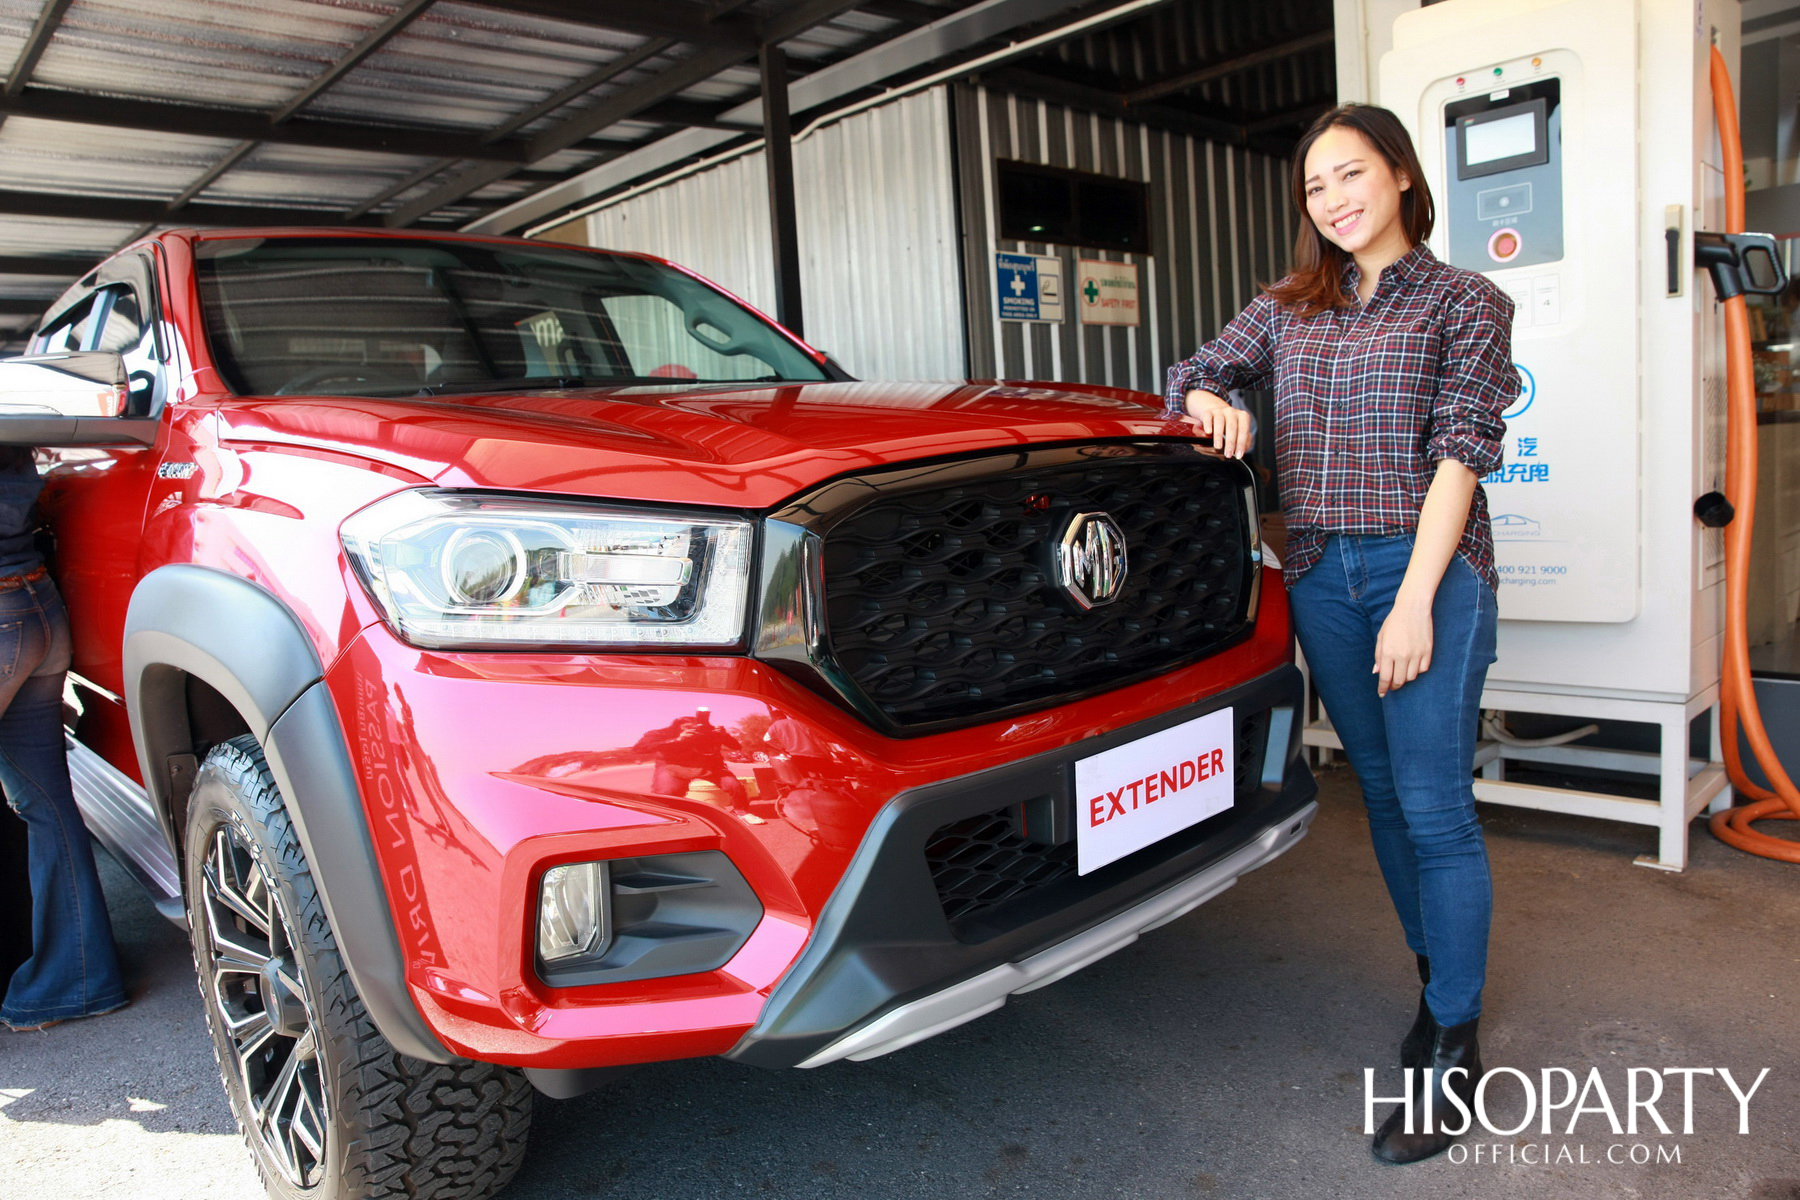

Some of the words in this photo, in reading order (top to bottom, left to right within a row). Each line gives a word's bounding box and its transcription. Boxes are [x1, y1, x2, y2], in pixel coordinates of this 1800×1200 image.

[1003, 297, 1035, 305] SMOKING
[1101, 298, 1120, 308] SAFETY
[1121, 299, 1136, 309] FIRST
[1517, 437, 1538, 457] 汽
[1517, 565, 1537, 575] 921
[1540, 565, 1567, 575] 9000
[1090, 748, 1225, 828] EXTENDER
